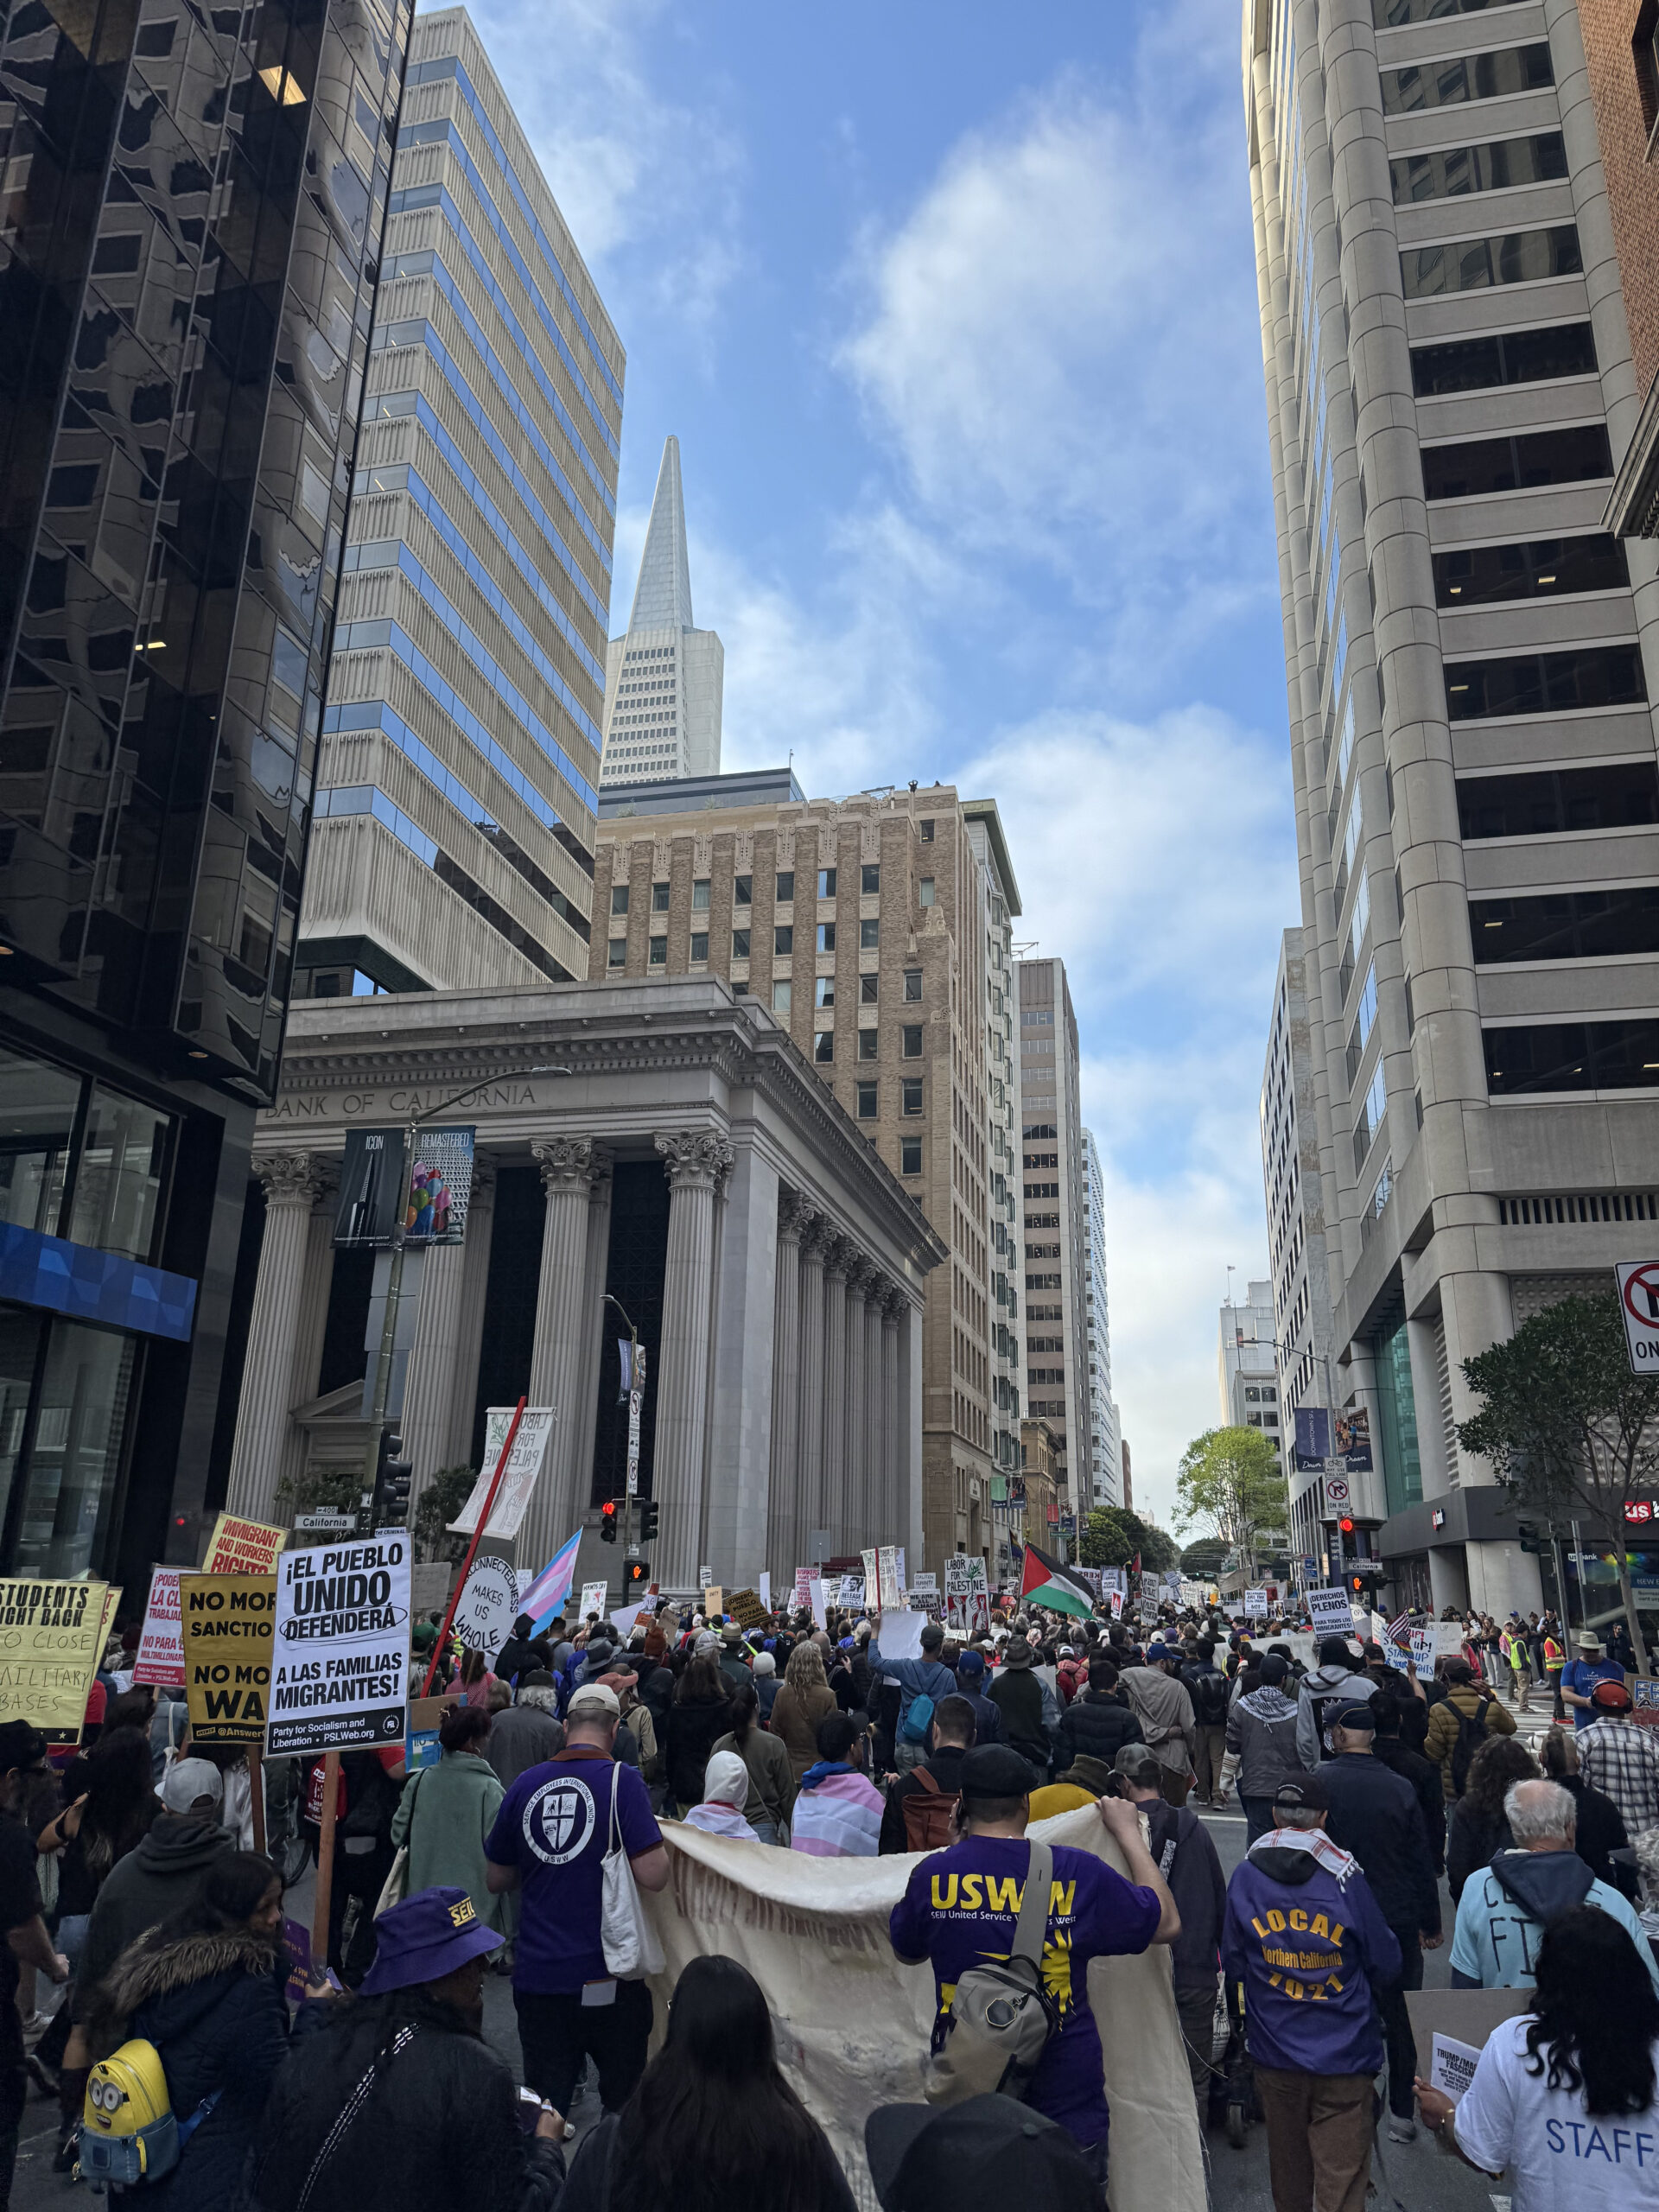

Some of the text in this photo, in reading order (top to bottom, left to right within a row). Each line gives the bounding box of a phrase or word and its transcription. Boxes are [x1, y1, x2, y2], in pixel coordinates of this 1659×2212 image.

[342, 1093, 375, 1114] OF
[389, 1084, 537, 1111] CALIFORNIA
[365, 1135, 385, 1150] ICON
[421, 1133, 469, 1148] REMASTERED
[302, 1517, 347, 1527] California
[222, 1520, 281, 1548] IMMIGRANT
[217, 1537, 275, 1564] AND WORKERS
[286, 1542, 403, 1585] ¡EL PUEBLO
[946, 1559, 966, 1570] LABOR
[154, 1574, 180, 1588] ¡PODE
[950, 1571, 961, 1580] FOR
[150, 1589, 164, 1606] LA
[189, 1592, 224, 1611] NO
[231, 1592, 276, 1611] MOR
[294, 1570, 391, 1616] UNIDO
[472, 1584, 504, 1606] MAKES
[474, 1604, 490, 1620] US
[1311, 1599, 1347, 1612] PLENOS
[0, 1606, 36, 1626] IGHT
[41, 1608, 85, 1627] BACK
[190, 1621, 272, 1637] SANCTIO
[455, 1614, 500, 1649] WHOLE
[33, 1630, 94, 1650] CLOSE
[143, 1636, 154, 1647] NO
[154, 1637, 176, 1649] PARA
[1414, 1642, 1432, 1652] UP!
[1415, 1652, 1428, 1662] UP
[194, 1665, 270, 1685] NO MO
[276, 1652, 402, 1685] A LAS FAMILIAS
[275, 1674, 399, 1711] MIGRANTES!
[205, 1690, 264, 1720] WA
[273, 1718, 365, 1738] Party for Socialism and
[272, 1729, 375, 1749] Liberation PSLWeb.org
[534, 1779, 563, 1801] EMPLOYEES
[563, 1778, 592, 1805] INTERNATIONAL
[948, 1910, 977, 1919] United
[980, 1910, 1013, 1922] Service
[1055, 1916, 1077, 1925] West
[1251, 1908, 1347, 1947] LOCAL
[1261, 1944, 1300, 1968] Northern
[1545, 2118, 1655, 2167] STAFF
